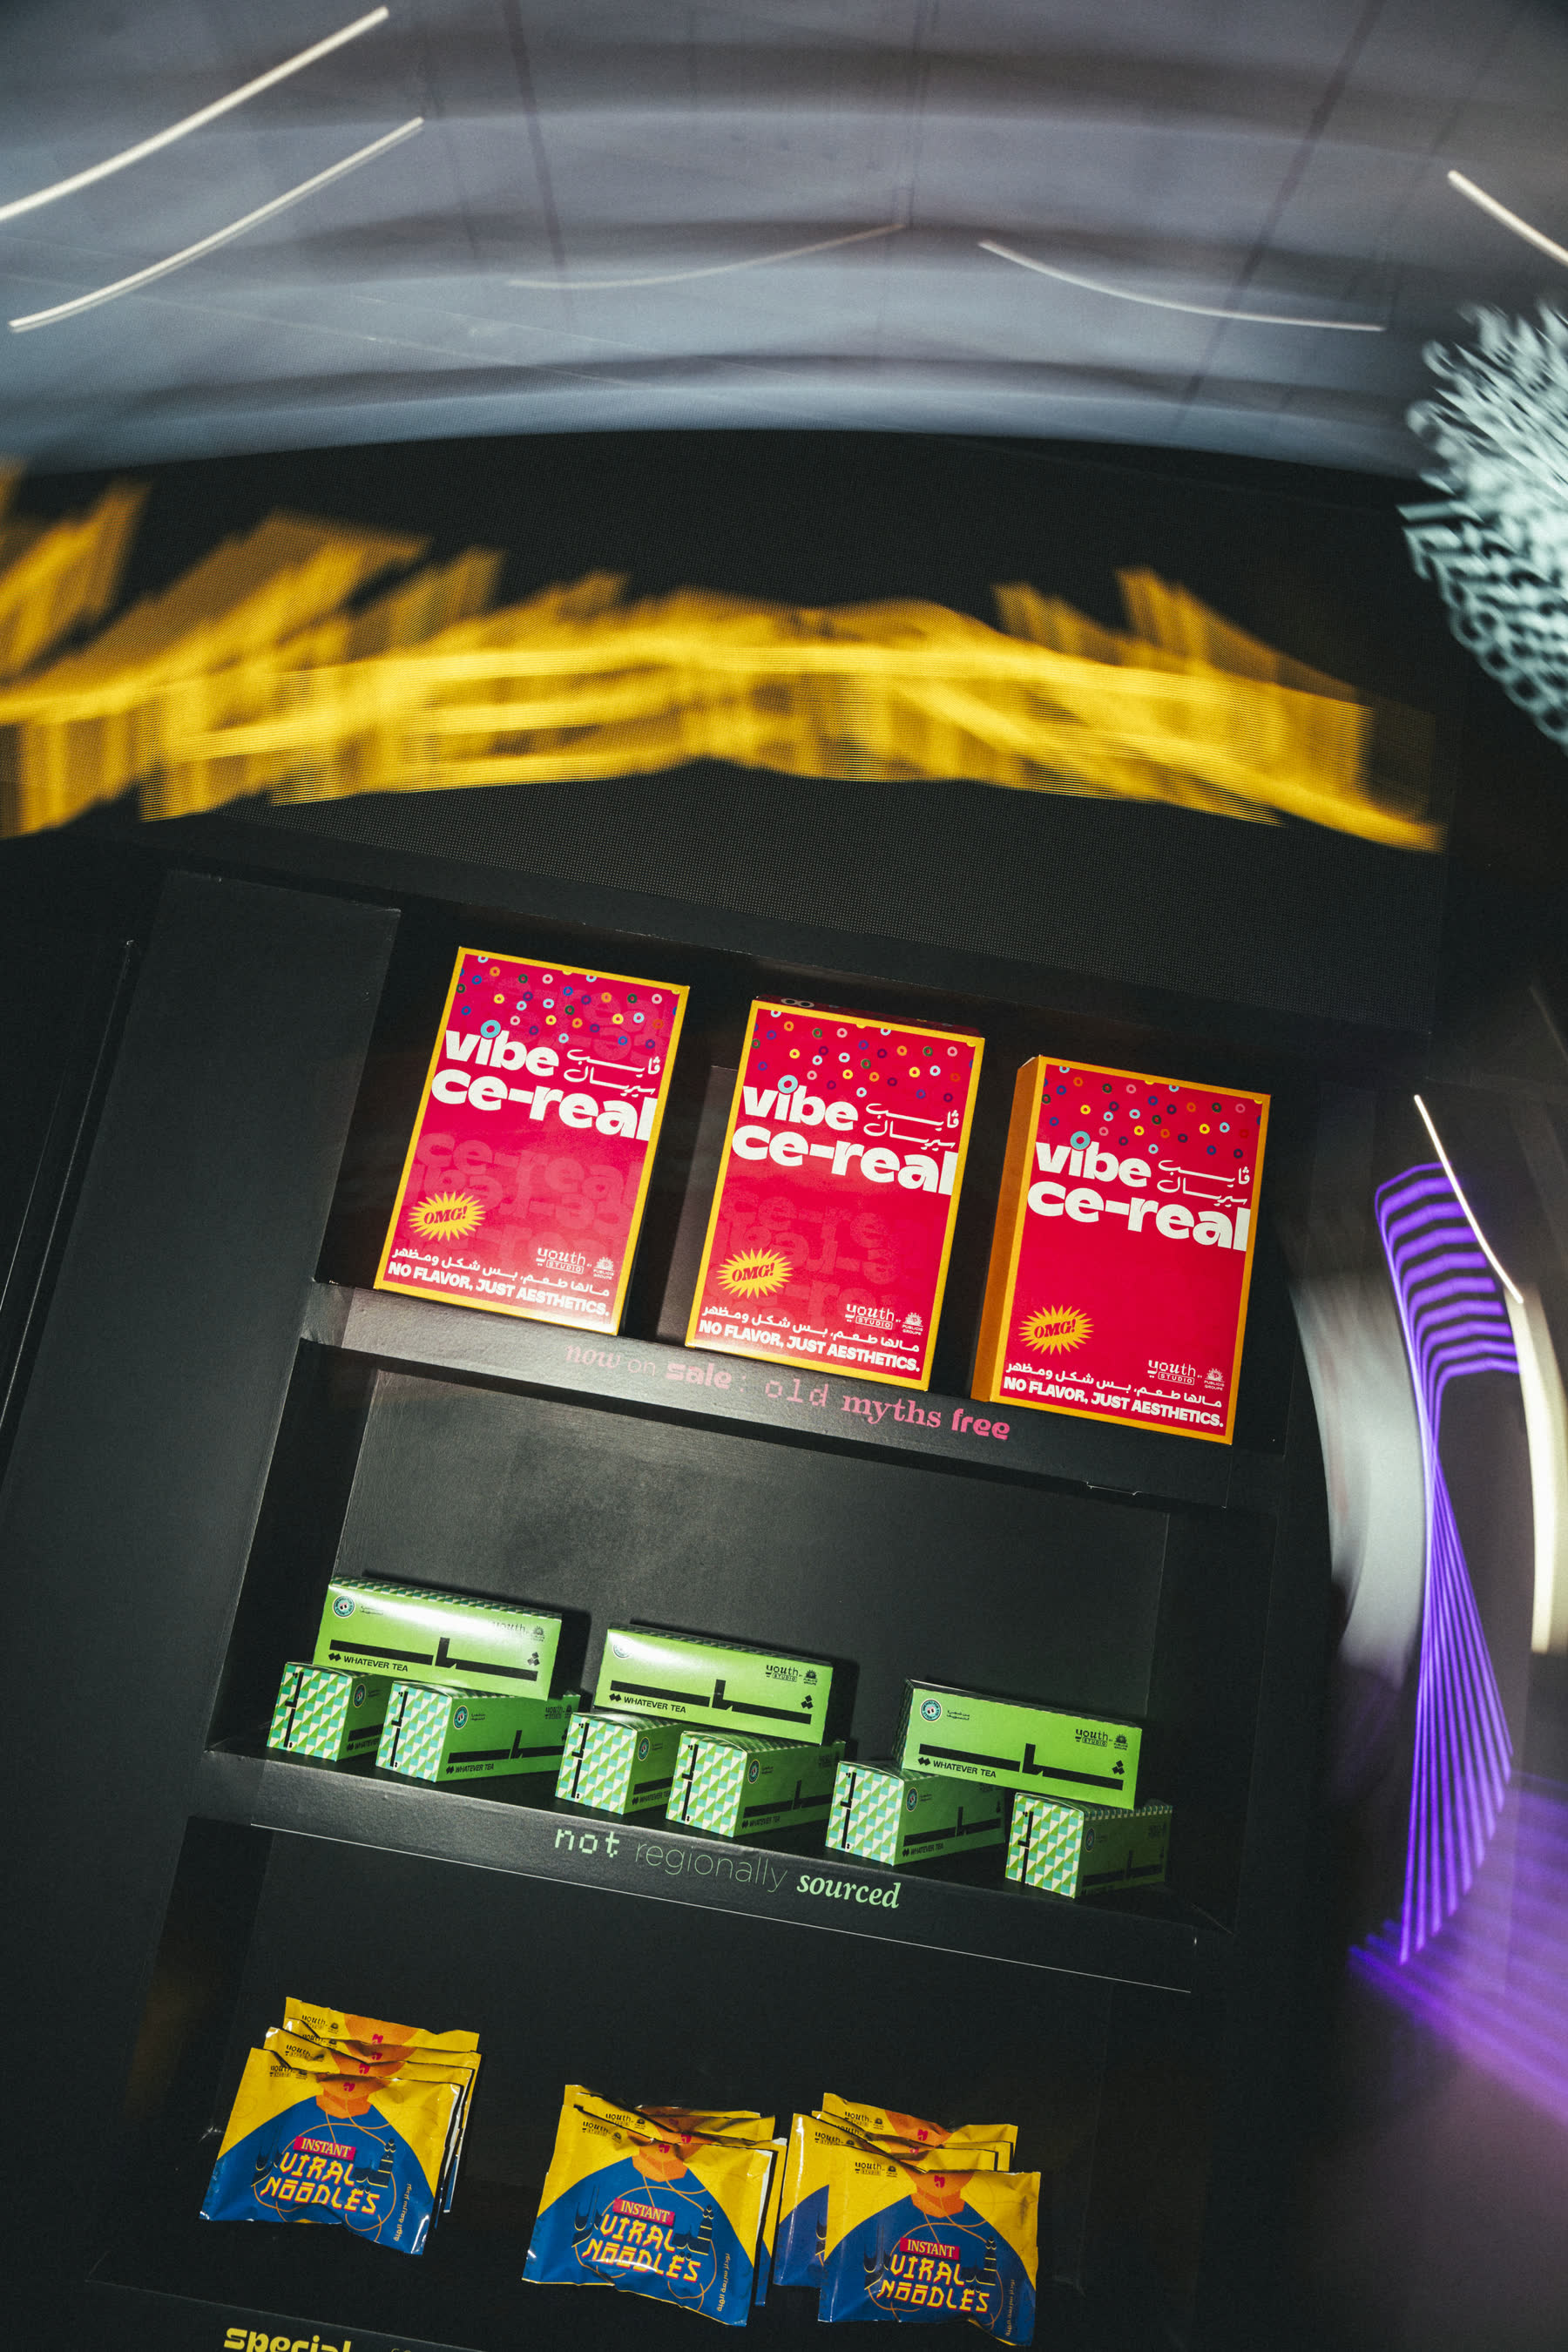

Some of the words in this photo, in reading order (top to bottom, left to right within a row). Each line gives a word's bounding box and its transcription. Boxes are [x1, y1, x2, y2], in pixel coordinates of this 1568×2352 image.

[444, 1019, 559, 1077] vibe
[431, 1069, 659, 1142] ce-real
[741, 1074, 860, 1132] vibe
[731, 1125, 959, 1197] ce-real
[1035, 1131, 1152, 1188] vibe
[422, 1205, 468, 1225] OMG!
[1026, 1180, 1252, 1253] ce-real
[442, 1256, 480, 1271] شكل
[536, 1247, 585, 1266] youth
[731, 1263, 775, 1281] OMG!
[388, 1260, 411, 1277] NO
[413, 1267, 473, 1292] FLAVOR,
[475, 1280, 516, 1298] JUST
[516, 1287, 610, 1316] AESTHETICS.
[751, 1316, 791, 1329] شكل
[845, 1304, 894, 1321] youth
[857, 1317, 891, 1328] STUDIO
[1033, 1318, 1077, 1339] OMG!
[699, 1319, 722, 1335] NO
[724, 1324, 784, 1349] FLAVOR,
[786, 1335, 826, 1355] JUST
[827, 1345, 921, 1373] AESTHETICS.
[1055, 1372, 1094, 1386] شكل
[1147, 1360, 1196, 1378] youth
[1159, 1373, 1193, 1383] STUDIO
[566, 1344, 621, 1369] now
[627, 1358, 656, 1376] on
[765, 1378, 828, 1408] old
[841, 1394, 942, 1428] myths
[951, 1408, 1010, 1441] free
[1004, 1376, 1027, 1392] NO
[1029, 1381, 1089, 1405] FLAVOR,
[1091, 1392, 1131, 1410] JUST
[1131, 1401, 1224, 1428] AESTHETICS.
[343, 1655, 389, 1669] WHATEVER
[392, 1663, 409, 1672] TEA
[624, 1696, 668, 1710] WHATEVER
[671, 1704, 686, 1713] TEA
[455, 1764, 483, 1774] WHATEVER
[933, 1760, 977, 1774] WHATEVER
[980, 1768, 997, 1778] TEA
[554, 1828, 619, 1858] not
[635, 1842, 788, 1893] regionally
[796, 1873, 901, 1909] sourced
[301, 2138, 351, 2158] INSTANT
[280, 2152, 355, 2186] VIRAL
[620, 2200, 670, 2223] INSTANT
[600, 2213, 675, 2253] VIRAL
[907, 2239, 956, 2258] INSTANT
[890, 2254, 965, 2287] VIRAL
